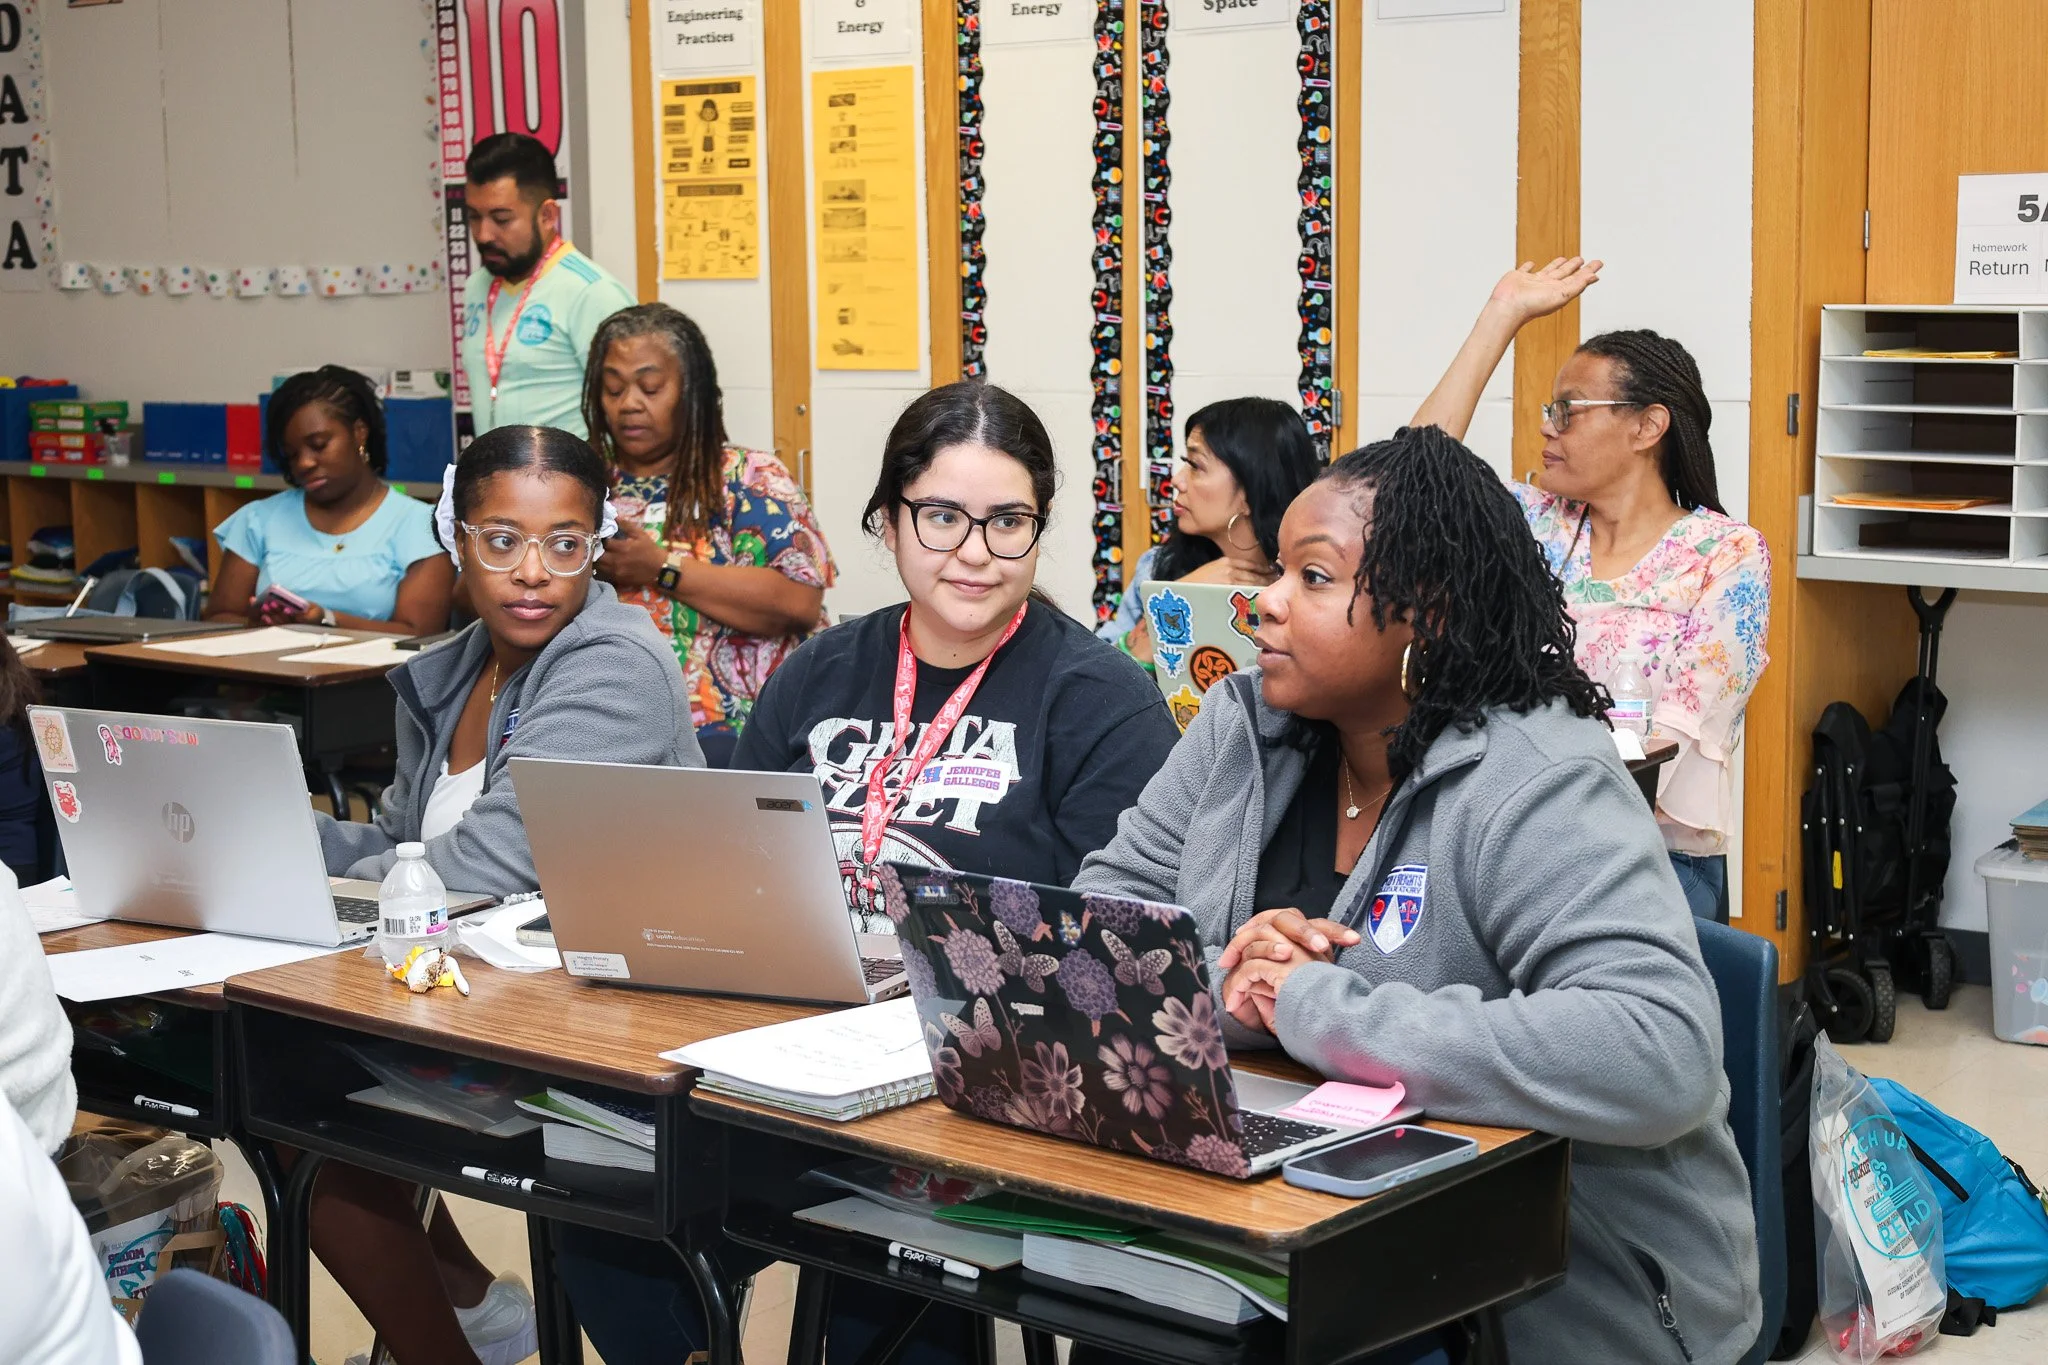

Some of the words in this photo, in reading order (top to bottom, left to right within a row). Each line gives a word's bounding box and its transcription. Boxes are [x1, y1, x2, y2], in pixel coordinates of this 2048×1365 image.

[667, 7, 744, 25] Engineering
[1011, 2, 1063, 16] Energy
[837, 21, 884, 34] Energy
[677, 31, 735, 45] Practices
[449, 224, 466, 239] 22
[1972, 243, 2028, 253] Homework
[1969, 260, 2029, 276] Return
[946, 766, 1001, 779] JENNIFER
[943, 777, 1001, 791] GALLEGOS
[1879, 1200, 1931, 1248] READ
[903, 1249, 925, 1262] EXPO
